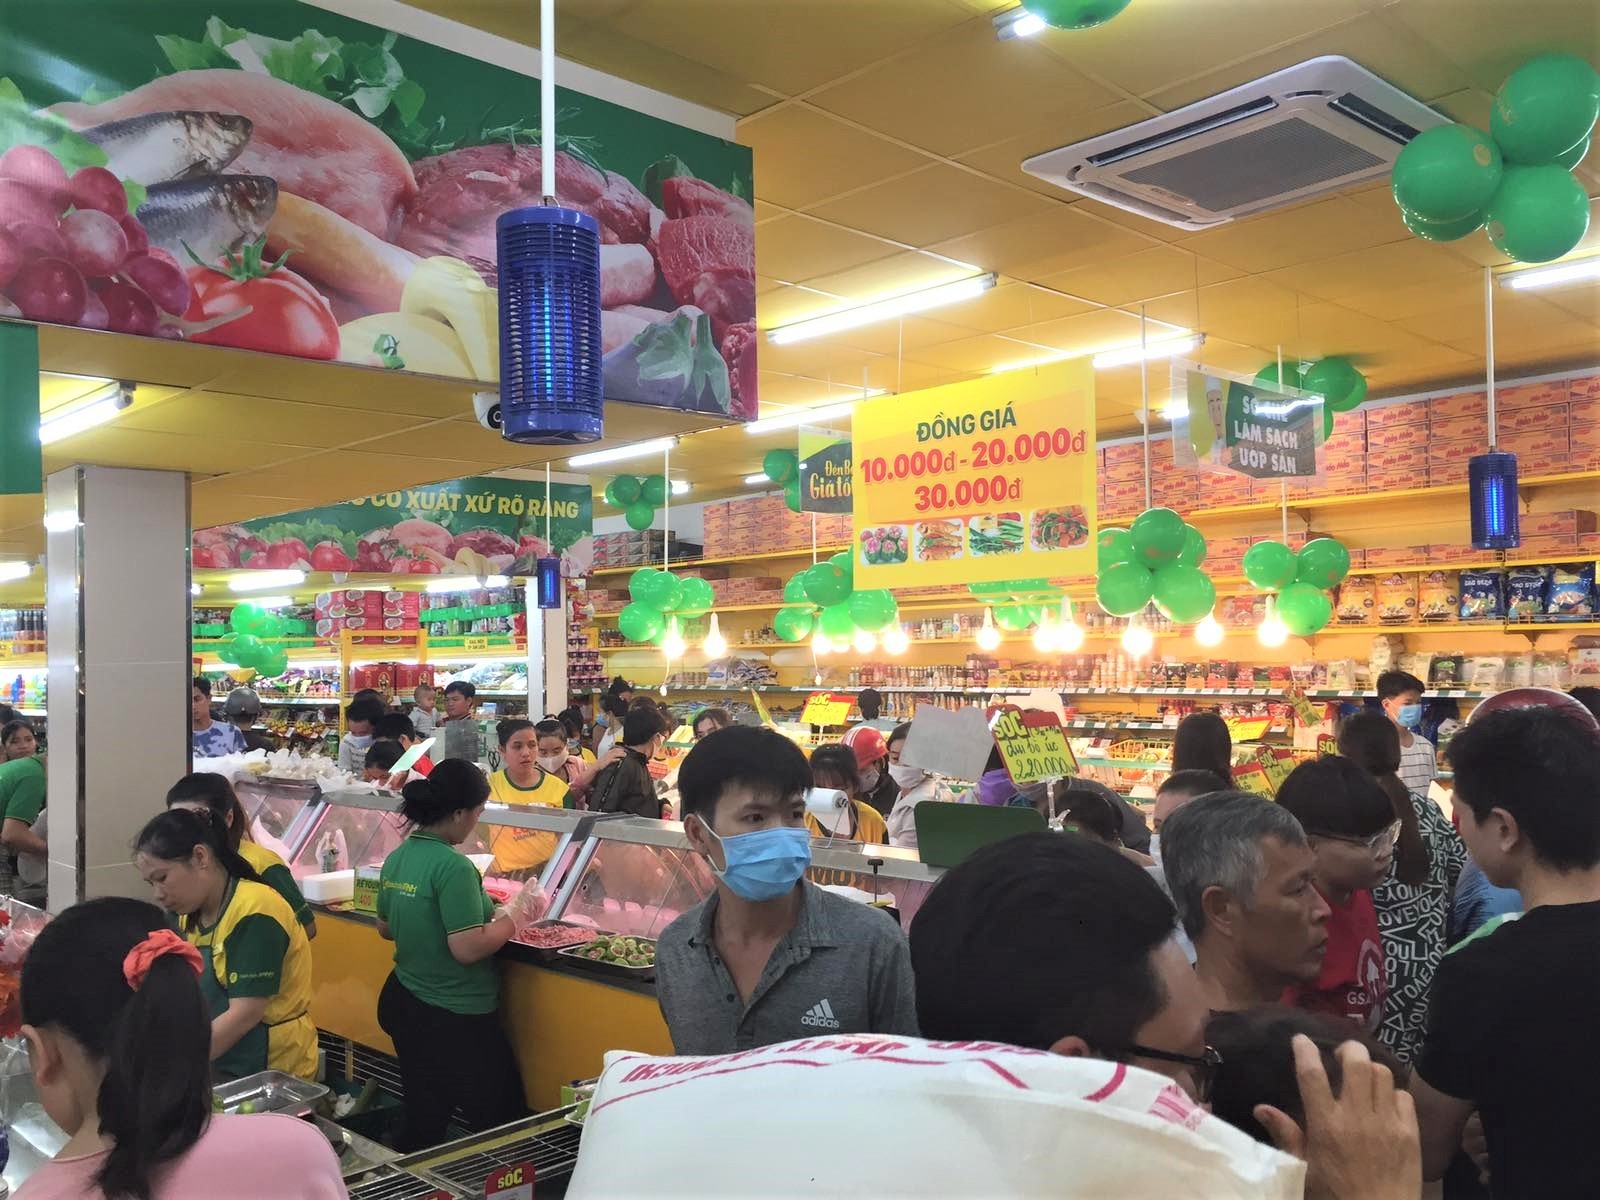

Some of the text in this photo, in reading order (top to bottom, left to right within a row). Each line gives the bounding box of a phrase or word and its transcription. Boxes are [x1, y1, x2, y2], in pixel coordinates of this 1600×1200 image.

[916, 401, 1017, 442] ĐỒNG GIÁ
[1265, 427, 1298, 450] SẠCH
[860, 448, 956, 483] 10.000đ
[972, 427, 1087, 468] 20.000đ
[810, 472, 836, 500] Giá
[914, 474, 1022, 511] 30.000đ
[464, 491, 496, 513] XỨ
[498, 494, 524, 515] RÕ
[527, 496, 579, 518] RÀNG
[800, 1016, 840, 1029] adidas
